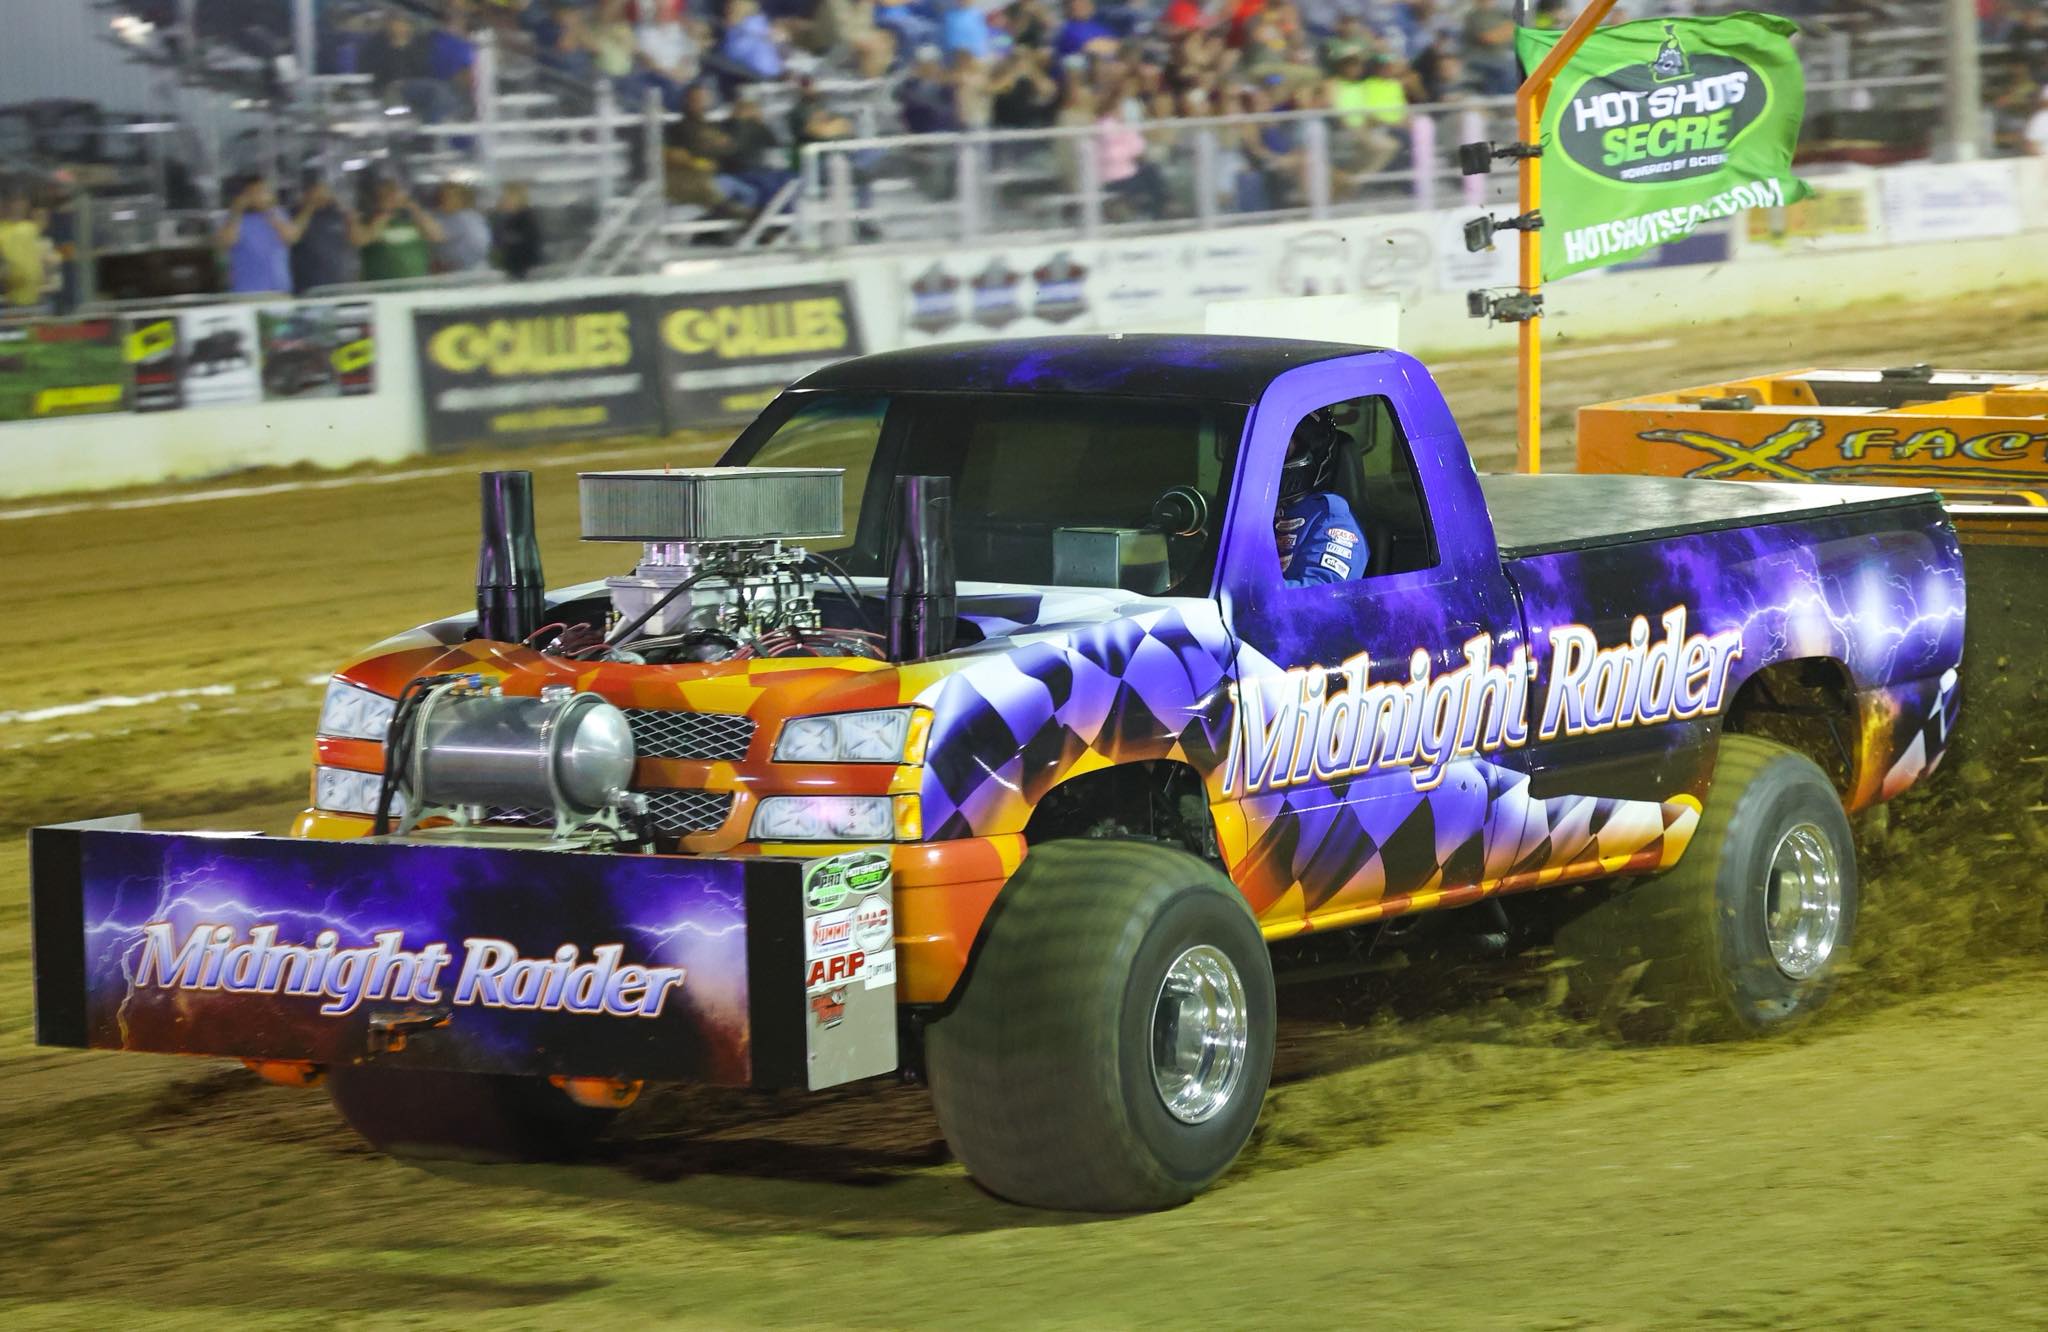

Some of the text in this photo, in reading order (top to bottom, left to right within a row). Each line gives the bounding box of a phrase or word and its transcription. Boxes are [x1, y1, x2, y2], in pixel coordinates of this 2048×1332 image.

[1573, 91, 1648, 132] HOT
[1602, 109, 1734, 167] SECRE
[1637, 418, 2048, 483] X FAC
[1222, 604, 1743, 795] Midnight Raider
[135, 921, 686, 1018] Midnight Raider
[806, 951, 865, 987] ARP
